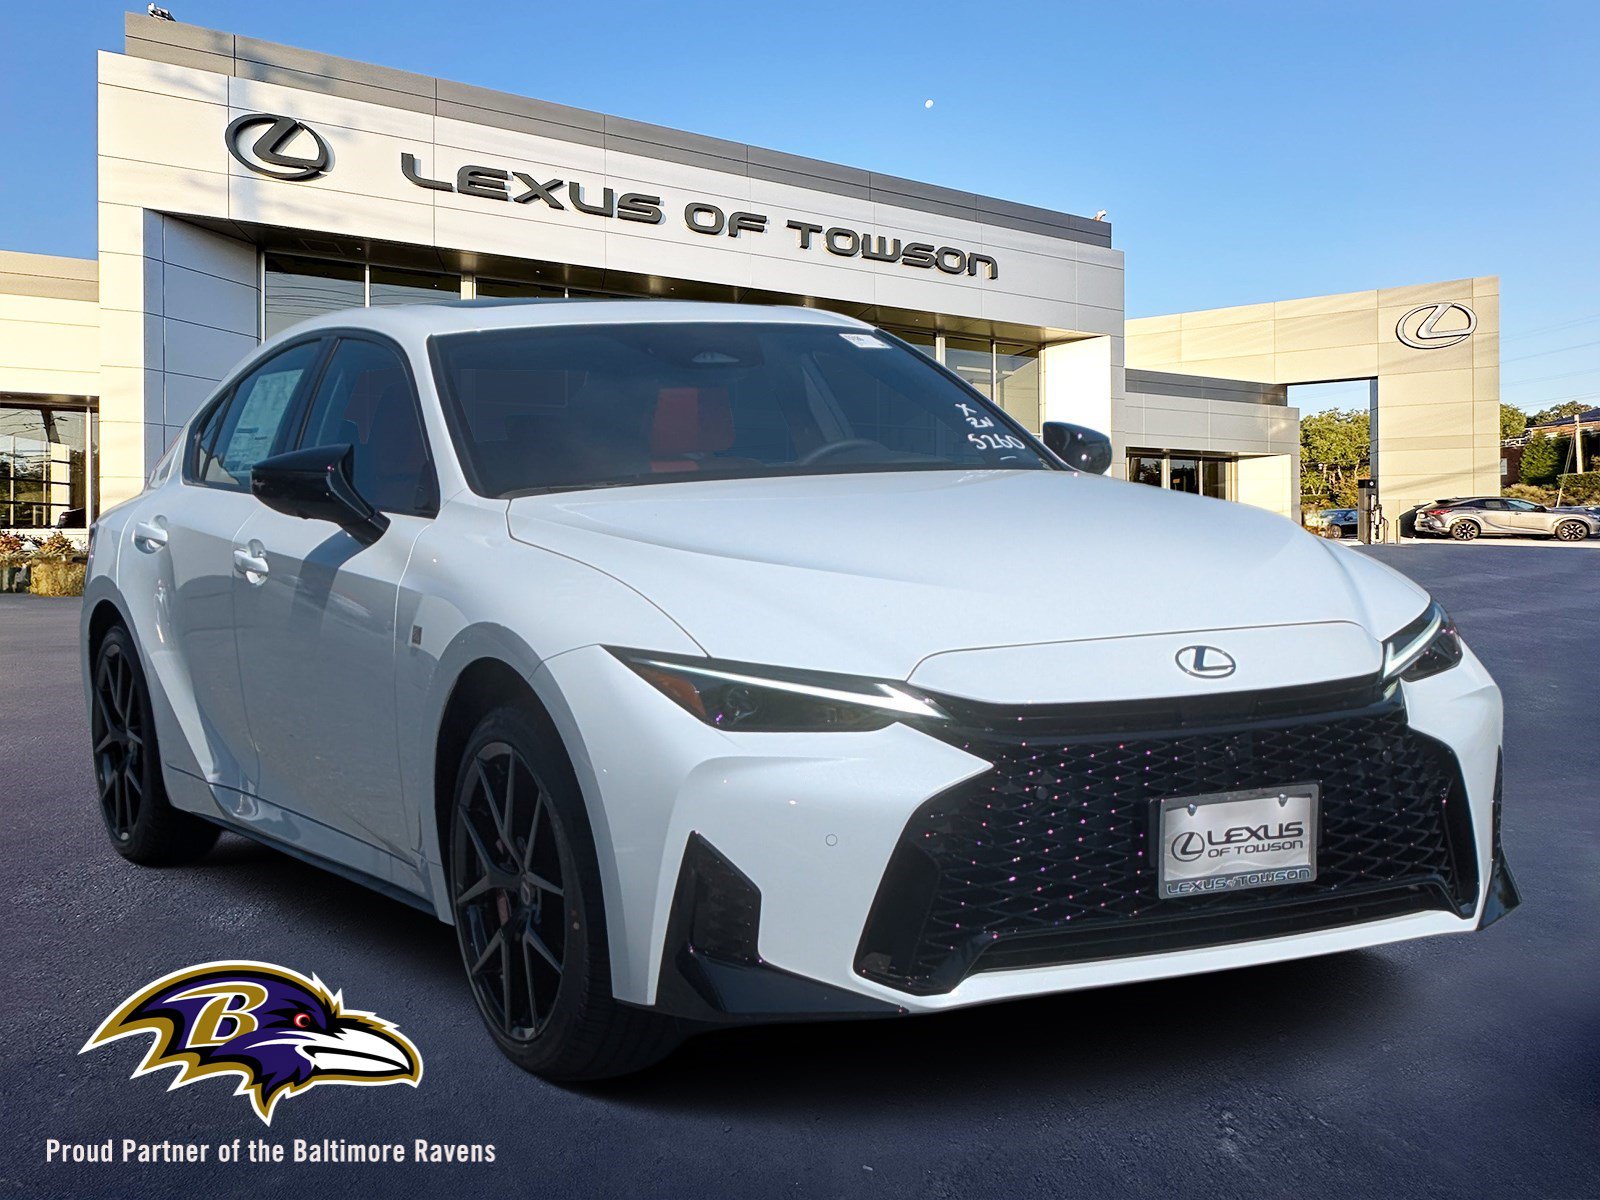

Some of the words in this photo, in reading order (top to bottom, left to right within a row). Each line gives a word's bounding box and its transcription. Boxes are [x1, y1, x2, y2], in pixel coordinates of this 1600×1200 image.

[400, 152, 664, 224] LEXUS
[684, 201, 769, 238] OF
[786, 218, 999, 280] TOWSON
[968, 434, 1025, 449] 5260
[1207, 822, 1304, 846] LEXUS
[1207, 847, 1231, 858] OF
[1235, 840, 1303, 855] TOWSON
[1167, 878, 1226, 895] LEXUS
[1237, 868, 1310, 884] TOWSON
